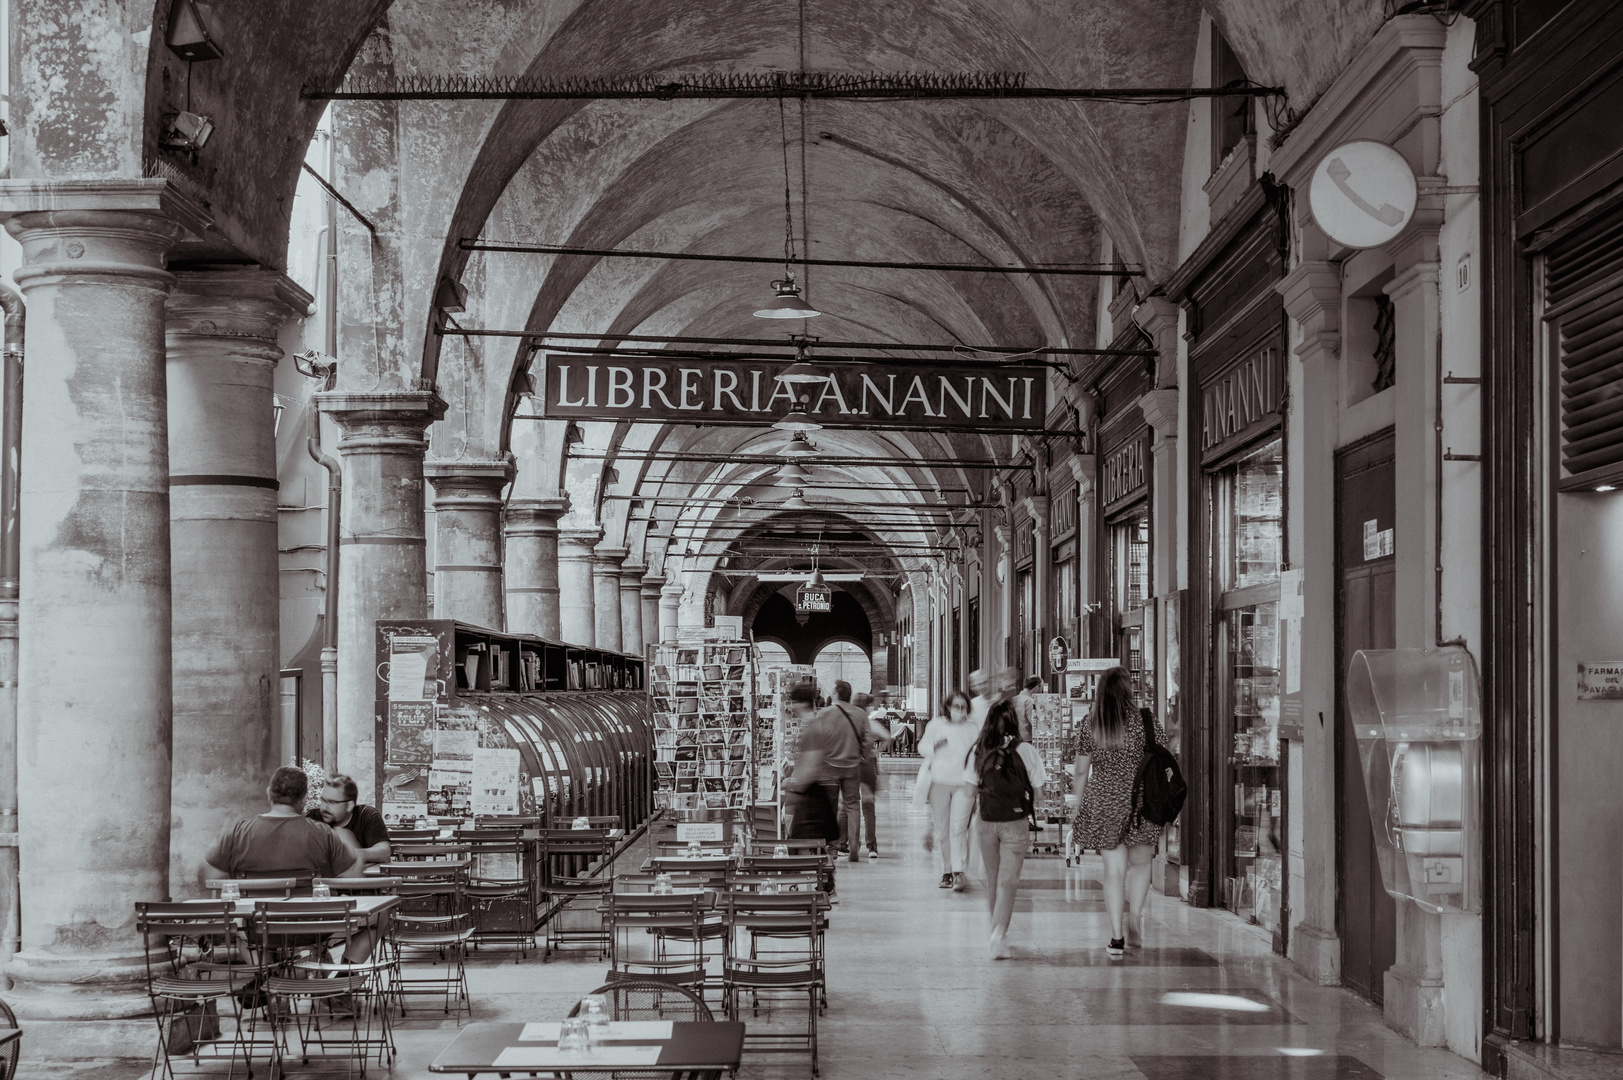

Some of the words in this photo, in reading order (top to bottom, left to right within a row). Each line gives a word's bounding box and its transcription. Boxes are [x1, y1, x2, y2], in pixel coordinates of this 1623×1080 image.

[1459, 264, 1468, 288] 10
[556, 365, 799, 412] LIBRERIA
[1103, 439, 1146, 508] LIBRERIA
[804, 593, 824, 601] BUCA
[397, 709, 426, 724] fruit
